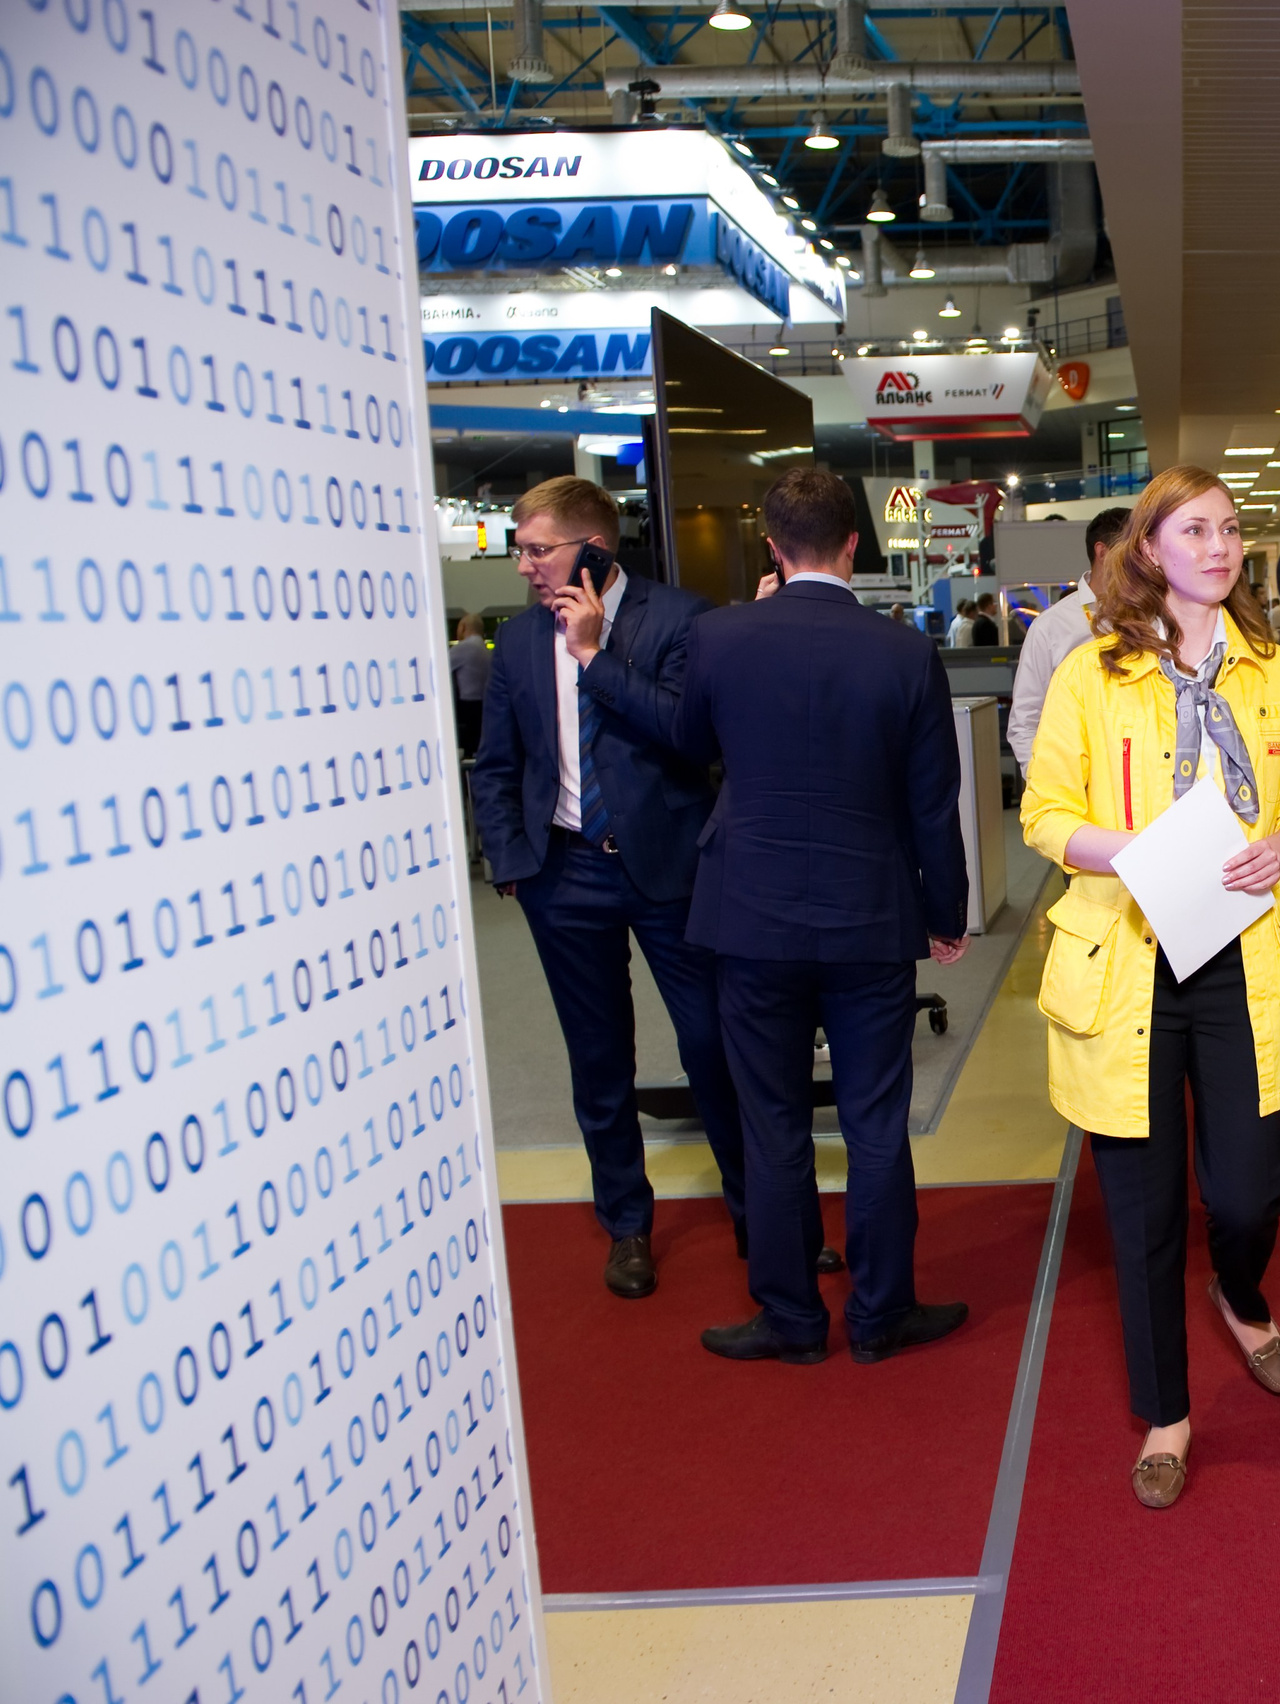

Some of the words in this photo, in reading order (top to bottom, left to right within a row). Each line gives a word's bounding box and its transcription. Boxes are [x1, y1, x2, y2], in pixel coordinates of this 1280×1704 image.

[418, 155, 582, 181] DOOSAN
[0, 176, 407, 366] 1101101110011
[5, 304, 414, 448] 1001010111100
[424, 333, 651, 376] OOSAN
[944, 388, 988, 398] FERMAT
[0, 554, 428, 624] 11001010010000
[0, 656, 436, 752] 00001101110011
[0, 900, 459, 1141] 011011110110110
[0, 1056, 474, 1413] 0010011000110100
[6, 1132, 482, 1539] 1010001101111001
[28, 1207, 489, 1651] 0011110010010000
